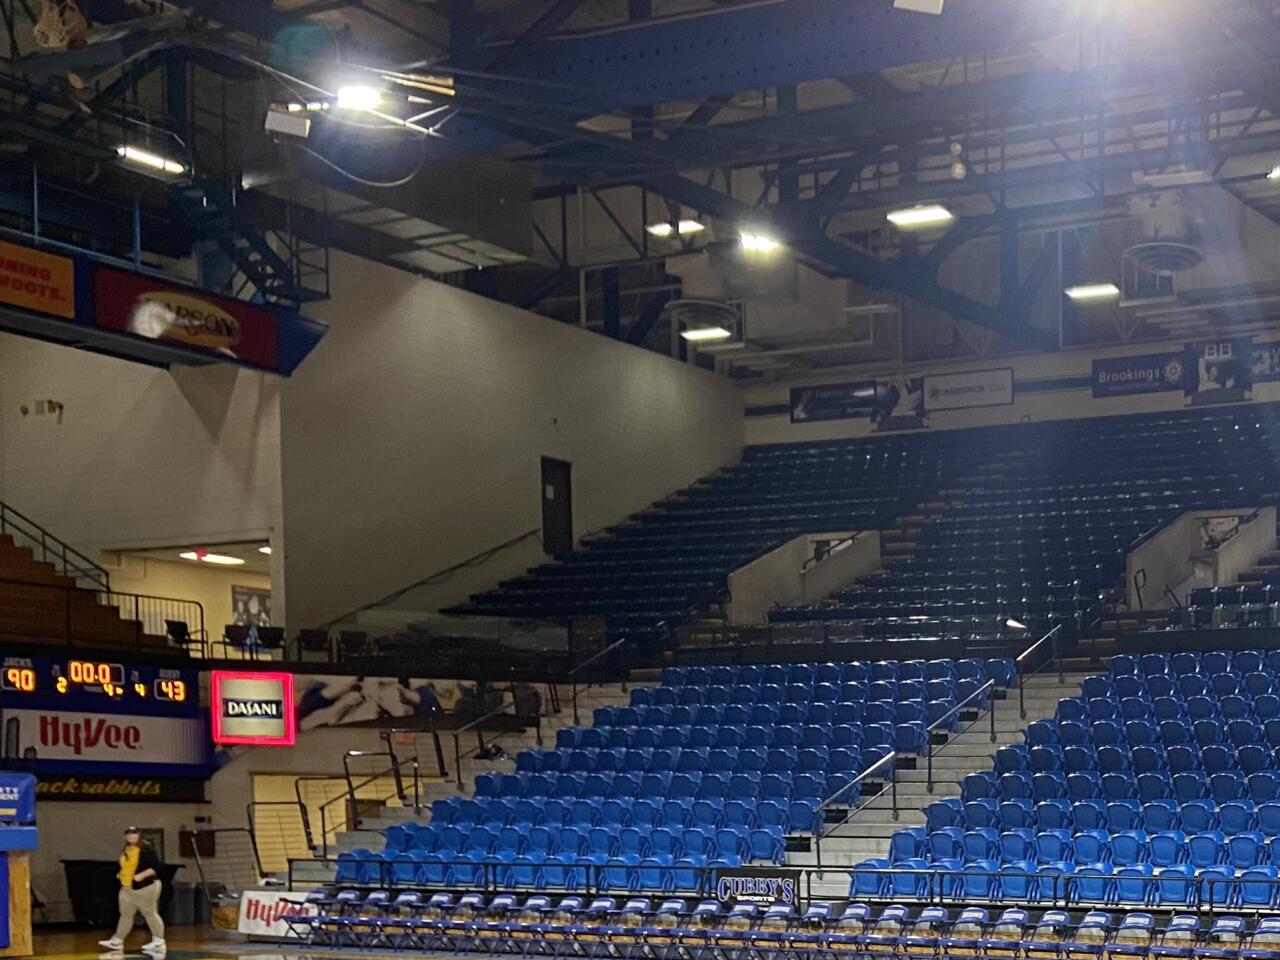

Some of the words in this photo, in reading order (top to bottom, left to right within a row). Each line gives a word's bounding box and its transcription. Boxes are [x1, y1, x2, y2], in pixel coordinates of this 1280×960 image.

[1204, 343, 1232, 359] BB
[1099, 367, 1160, 384] Brookings
[7, 668, 36, 692] 90
[161, 680, 186, 702] 43
[228, 701, 277, 716] DASANI
[35, 777, 161, 796] ackrabbits
[717, 876, 795, 904] CUBBY'S
